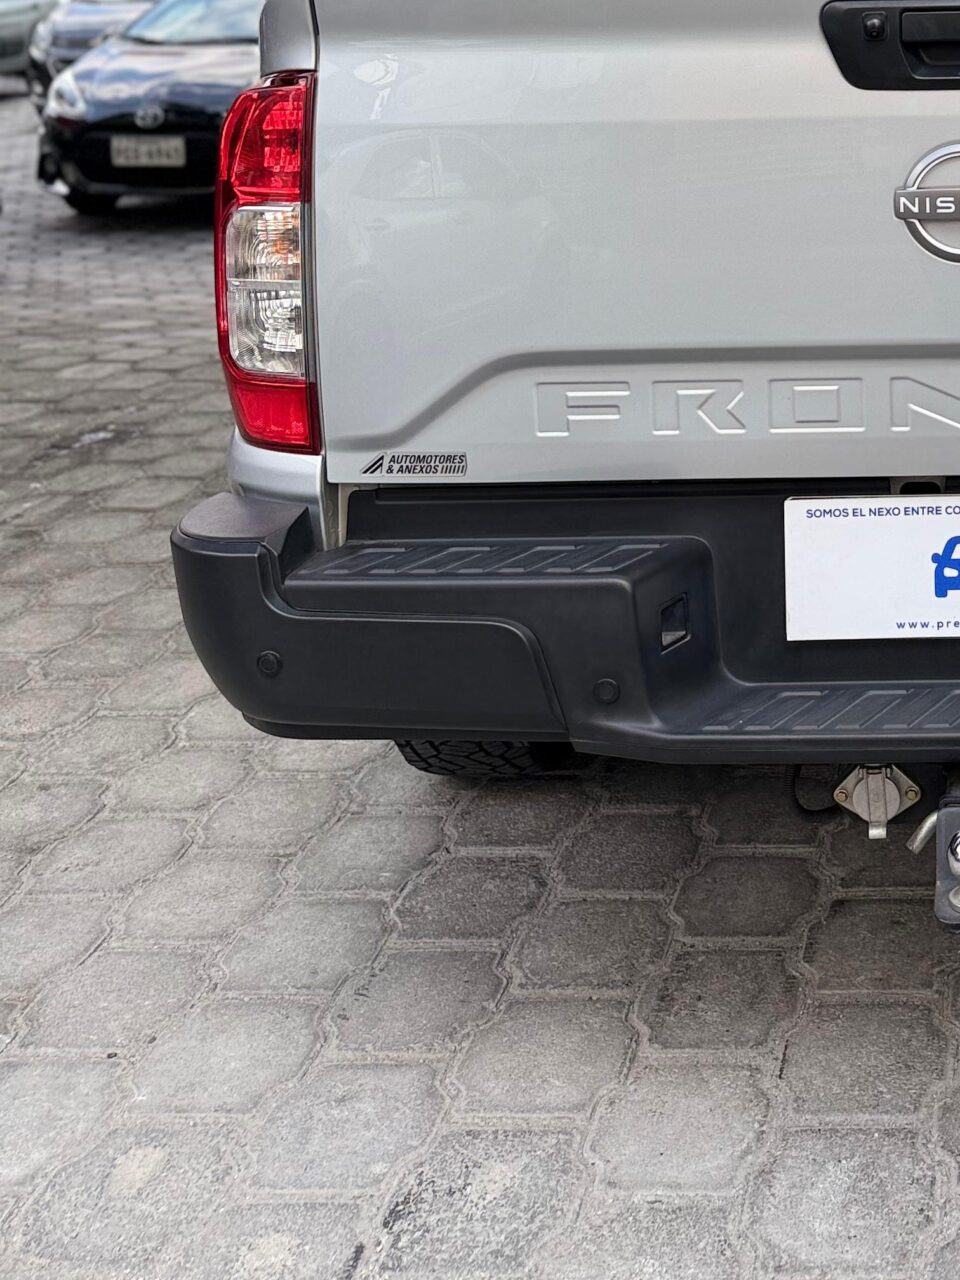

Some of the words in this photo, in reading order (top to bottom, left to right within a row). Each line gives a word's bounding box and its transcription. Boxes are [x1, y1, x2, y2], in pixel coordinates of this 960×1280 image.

[388, 454, 466, 465] AUTOMOTORES
[386, 464, 395, 475] &
[396, 464, 440, 475] ANEXOS
[805, 508, 850, 519] SOMOS
[852, 507, 867, 517] EL
[868, 506, 901, 517] NEXO
[903, 505, 942, 516] ENTRE
